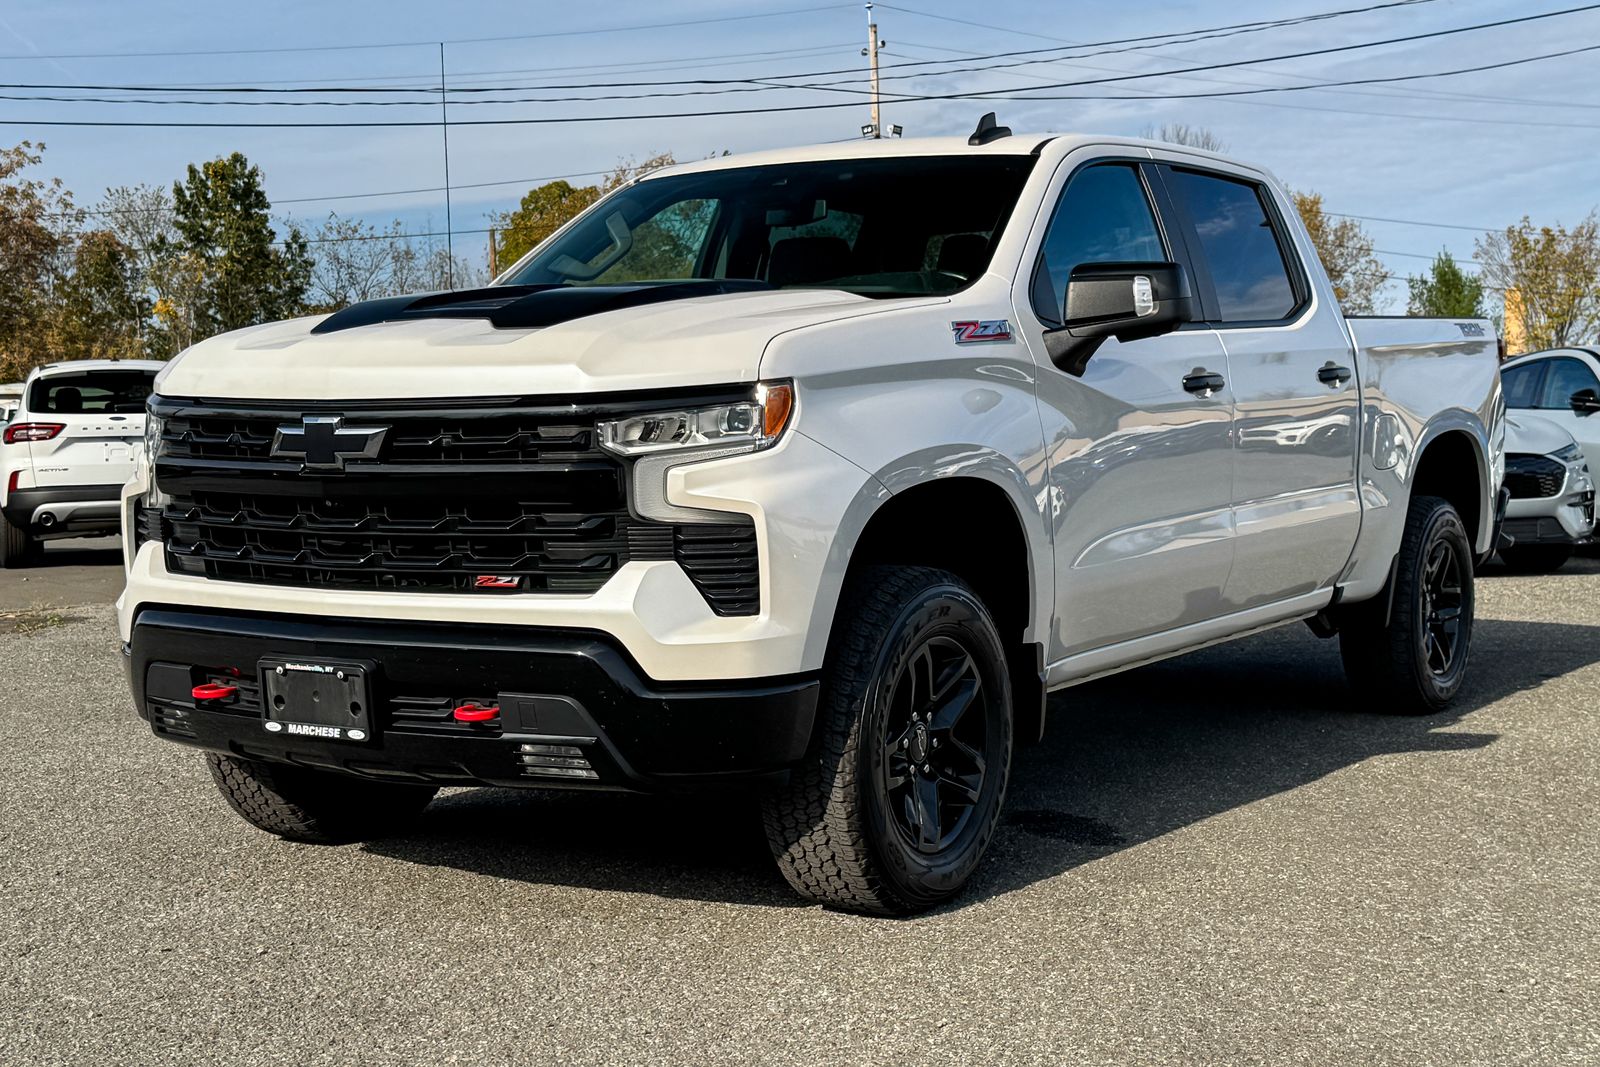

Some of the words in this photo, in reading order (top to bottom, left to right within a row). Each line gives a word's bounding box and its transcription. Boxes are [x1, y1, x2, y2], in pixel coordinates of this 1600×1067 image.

[951, 320, 1011, 344] Z71
[475, 575, 520, 588] Z71
[288, 723, 341, 738] MARCHESE
